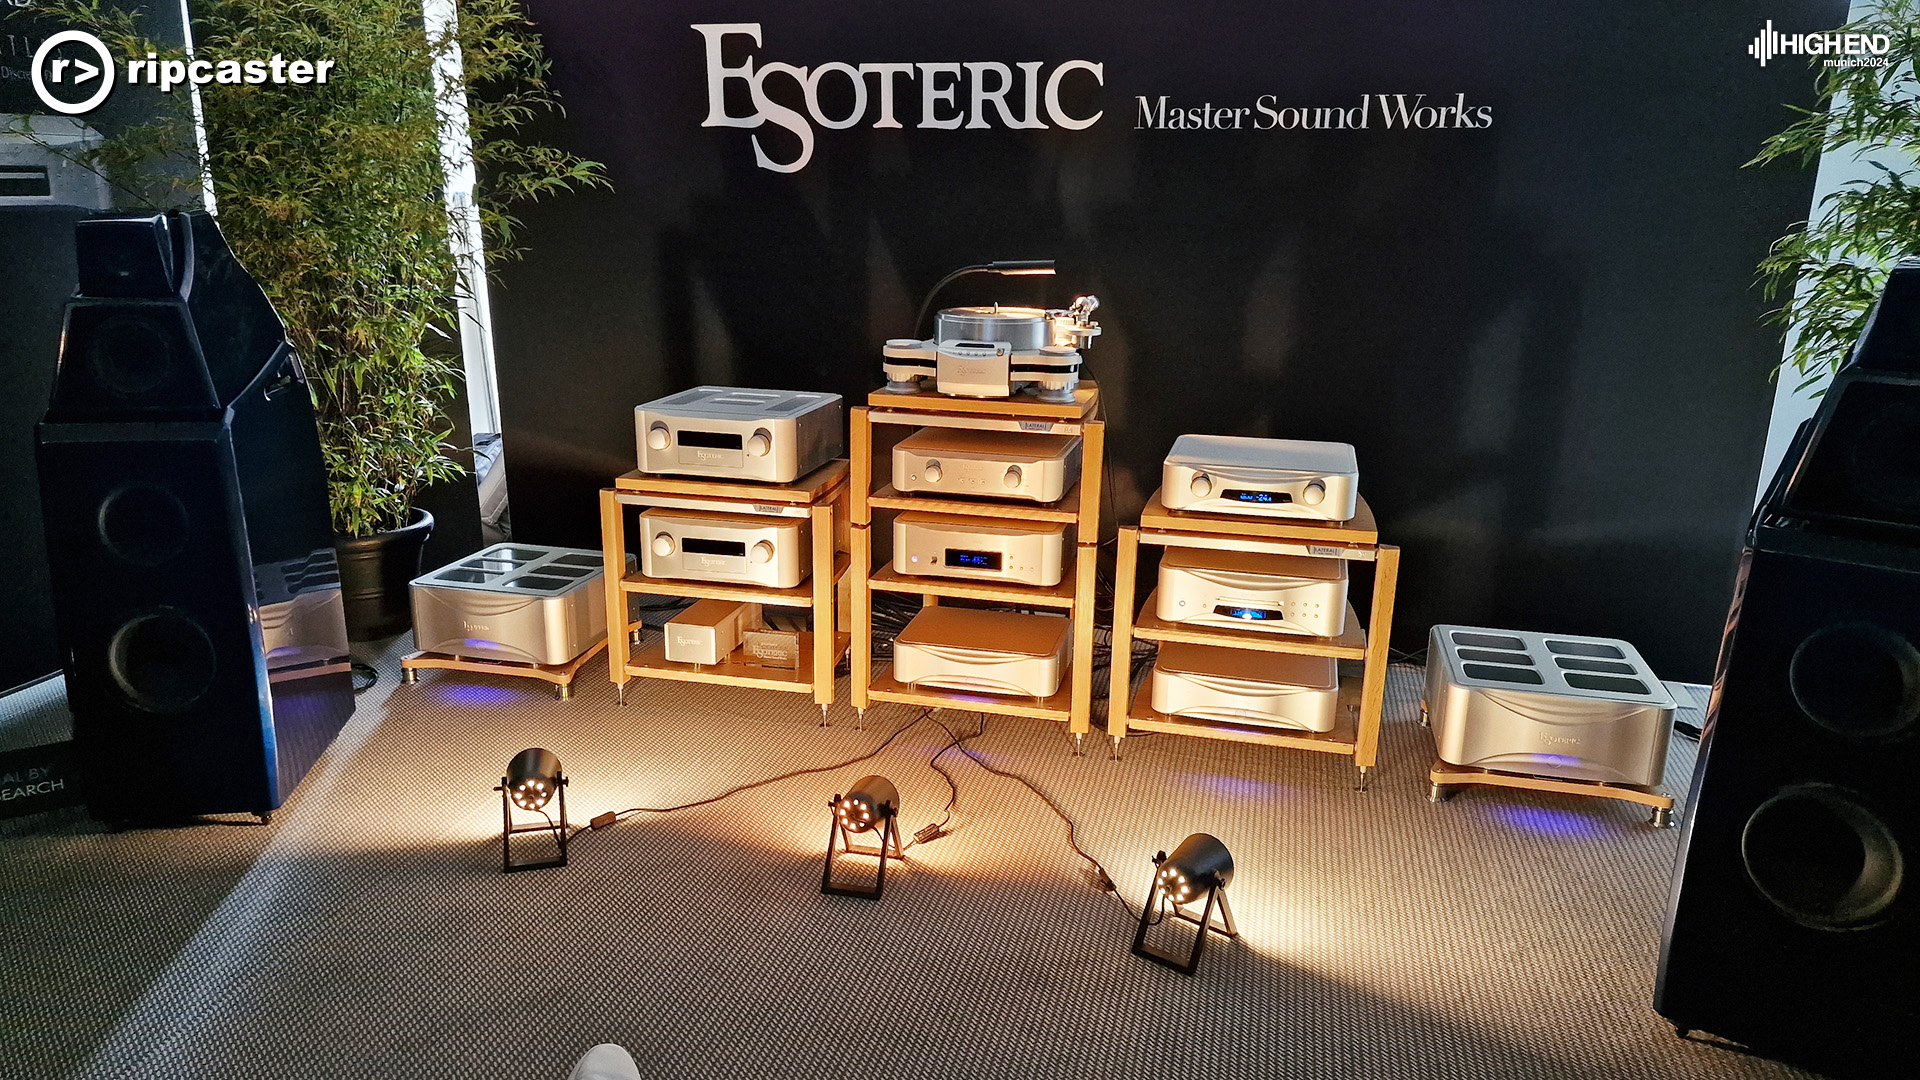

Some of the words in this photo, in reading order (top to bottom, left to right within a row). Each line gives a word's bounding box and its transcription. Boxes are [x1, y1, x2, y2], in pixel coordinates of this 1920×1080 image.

[1134, 95, 1250, 130] Master
[1253, 93, 1370, 130] Sound
[1374, 93, 1493, 130] Works
[28, 766, 50, 781] BY
[0, 777, 65, 802] EARCH
